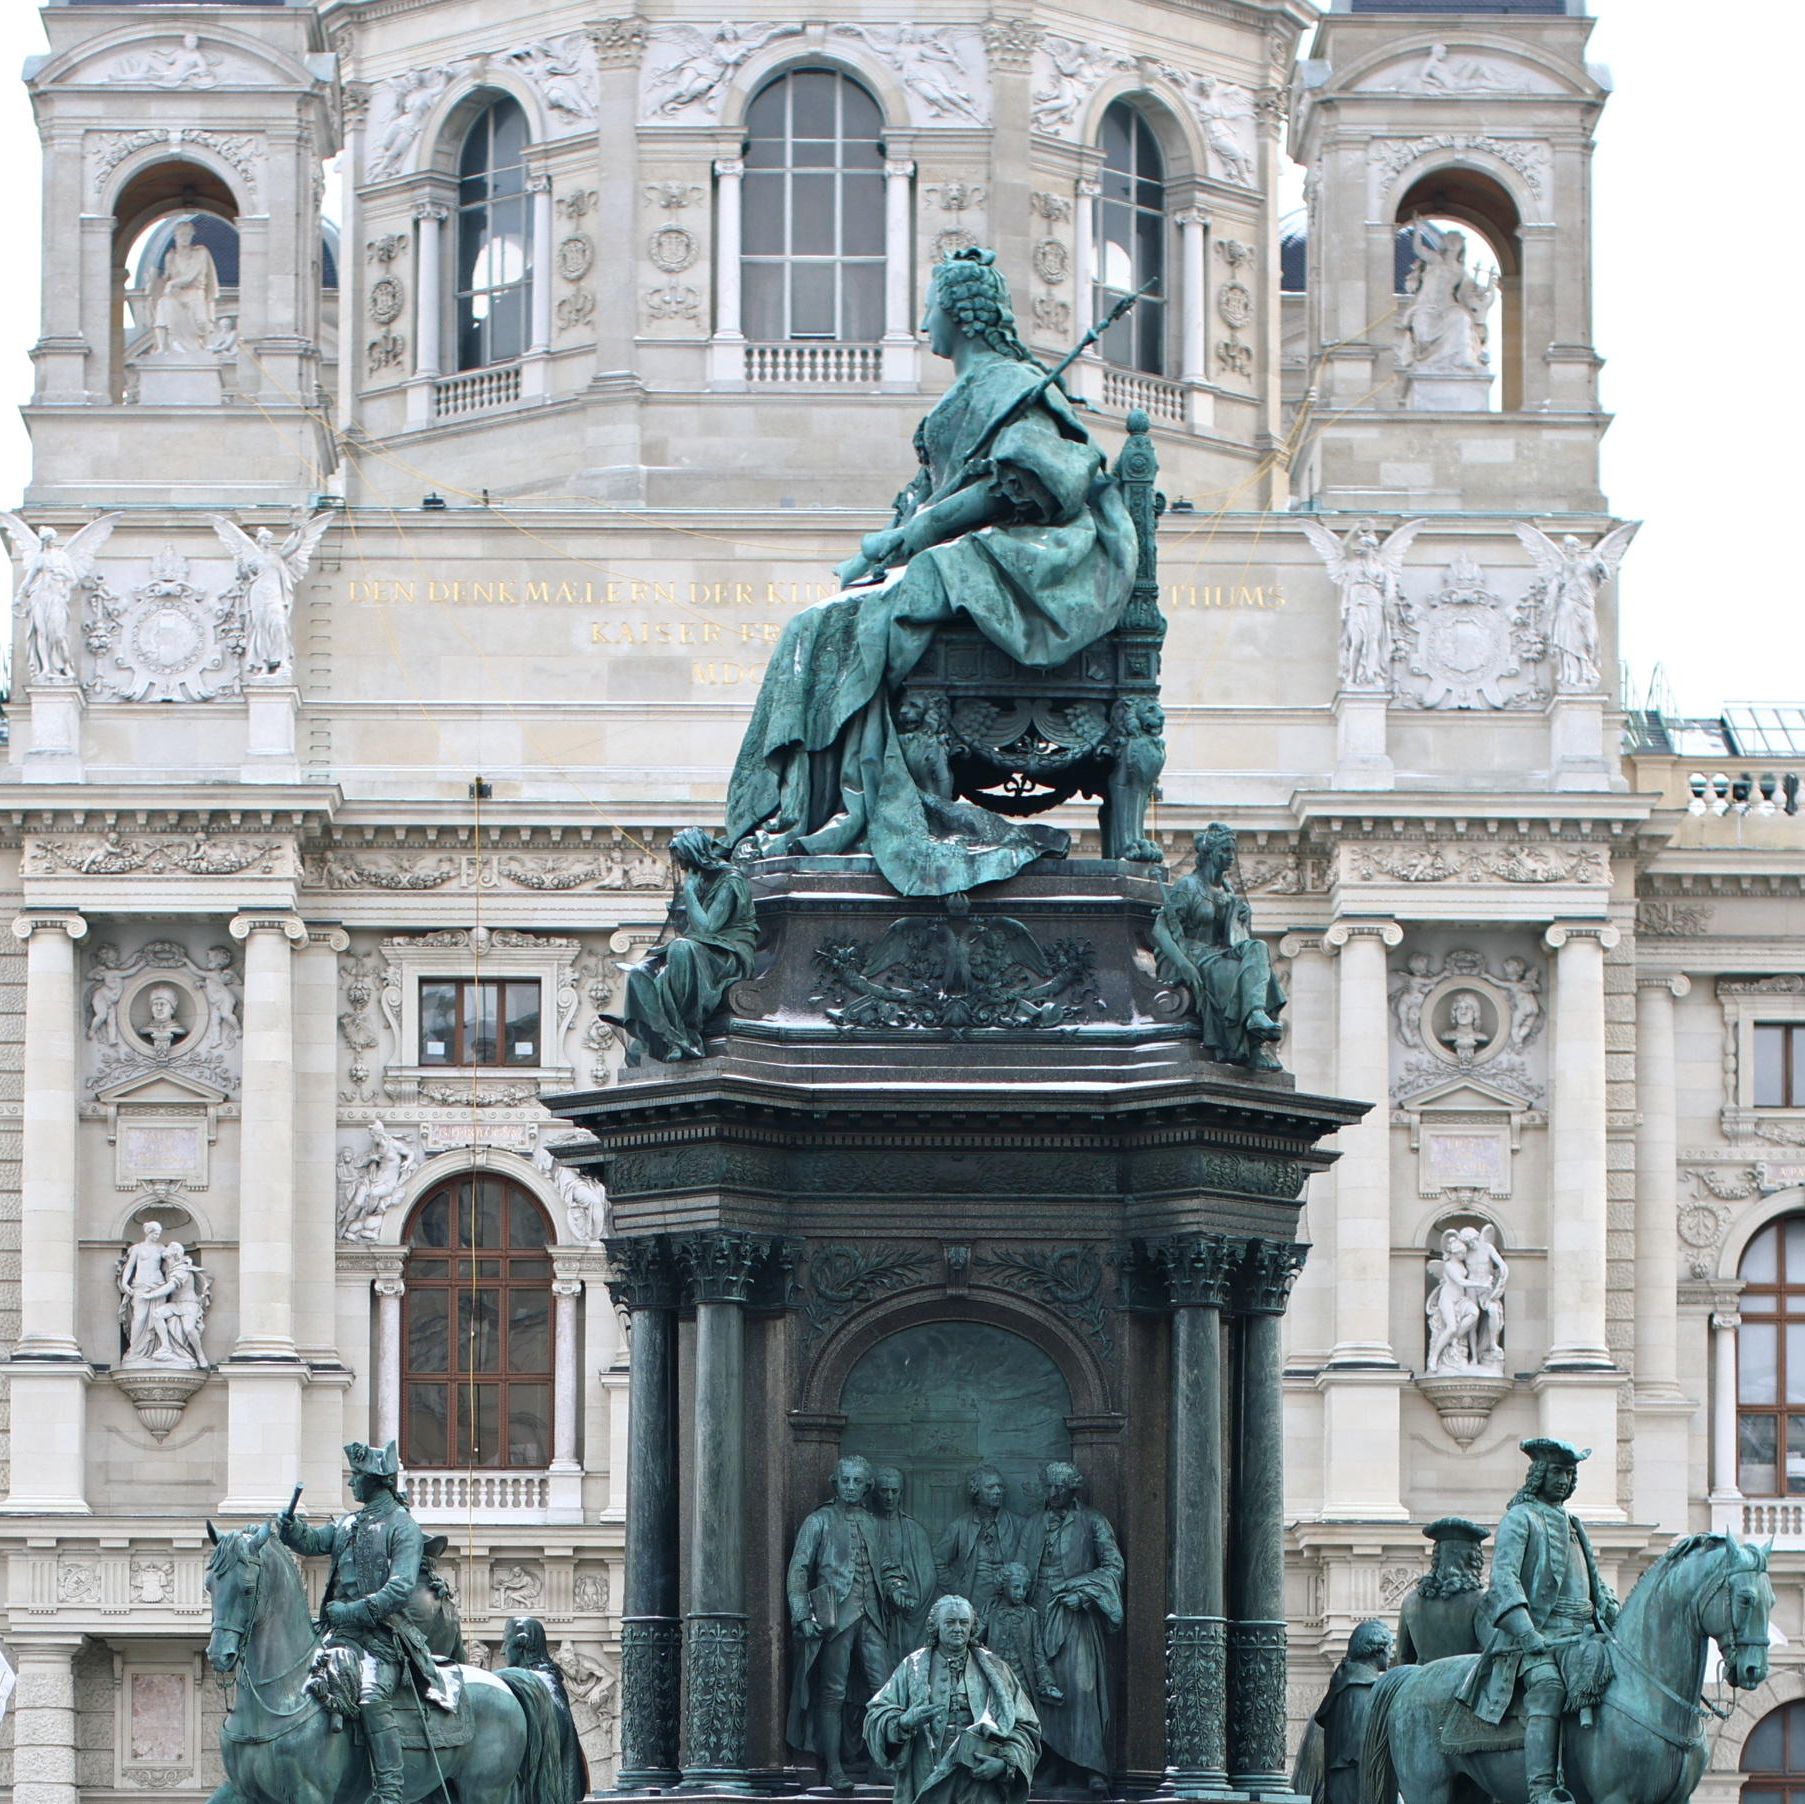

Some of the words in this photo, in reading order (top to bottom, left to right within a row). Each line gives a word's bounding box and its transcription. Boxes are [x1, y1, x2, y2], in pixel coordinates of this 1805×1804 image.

[349, 580, 416, 606] DEN
[689, 581, 754, 606] DER
[591, 621, 722, 646] KAISER
